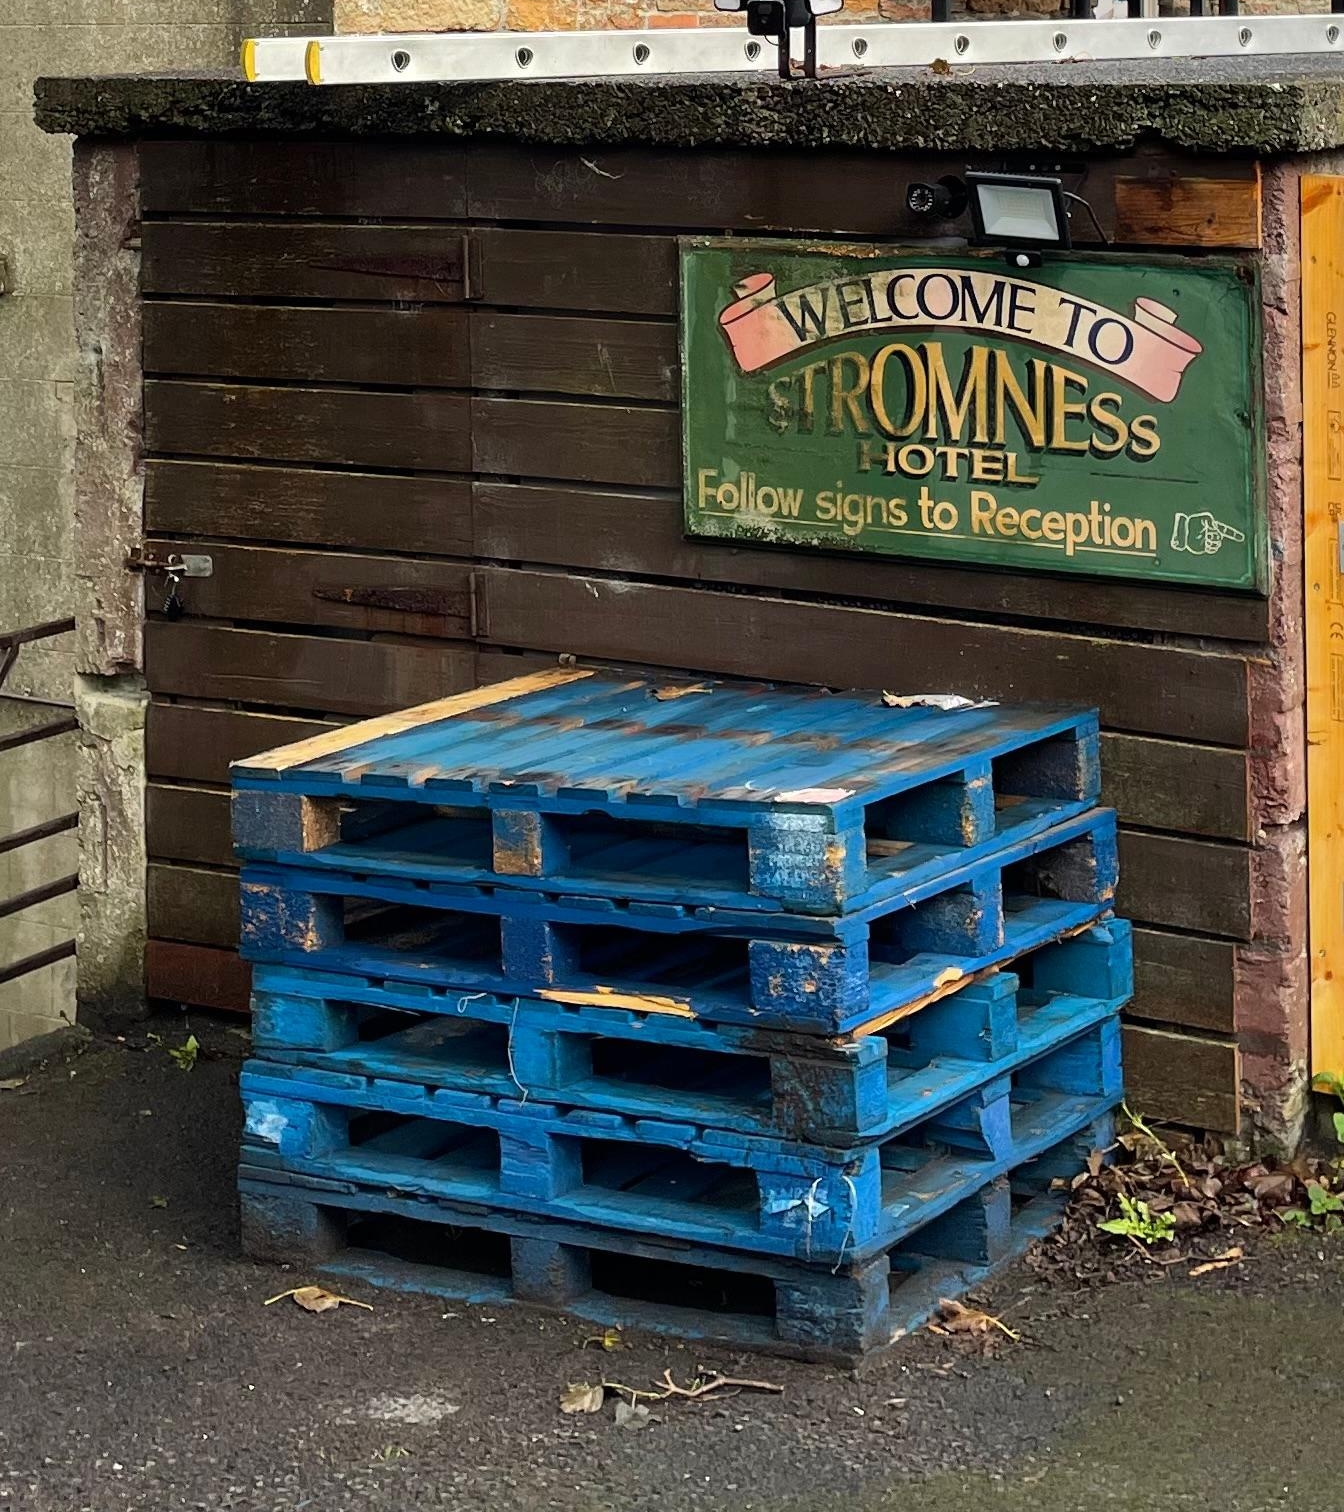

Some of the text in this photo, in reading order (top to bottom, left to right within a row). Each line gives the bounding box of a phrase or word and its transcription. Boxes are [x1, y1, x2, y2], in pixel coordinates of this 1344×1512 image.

[776, 273, 1134, 365] WELCOME TO
[1326, 311, 1337, 371] GLENNON
[768, 342, 1161, 461] STROMNESS
[858, 440, 1040, 487] HOTEL
[698, 467, 1157, 556] Follow signs to Reception
[1329, 622, 1344, 640] CE
